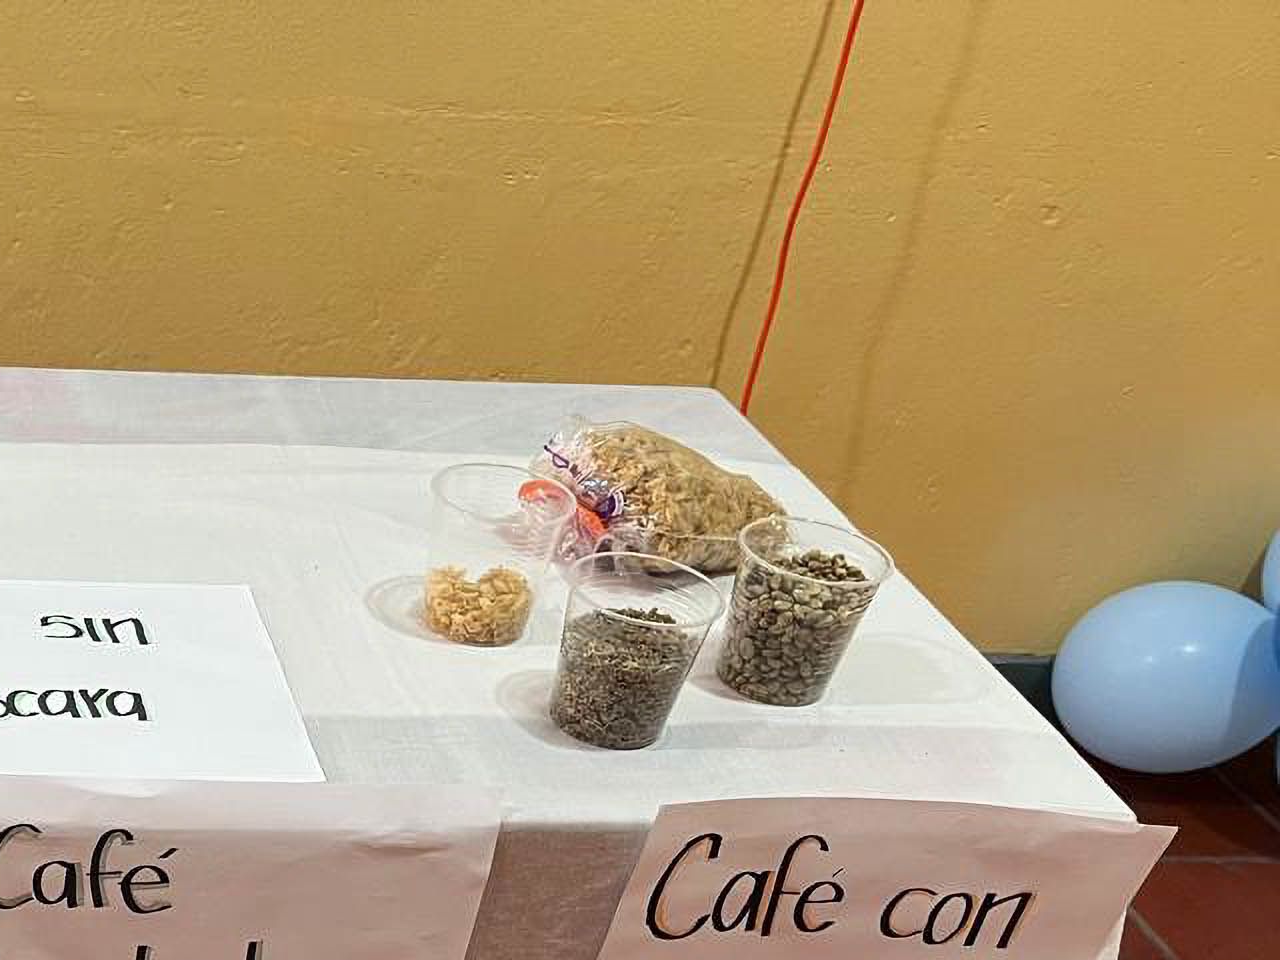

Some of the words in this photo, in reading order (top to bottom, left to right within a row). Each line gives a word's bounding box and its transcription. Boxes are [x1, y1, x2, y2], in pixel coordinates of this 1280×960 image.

[40, 612, 148, 646] sin
[646, 833, 845, 941] Café
[880, 886, 1035, 950] con
